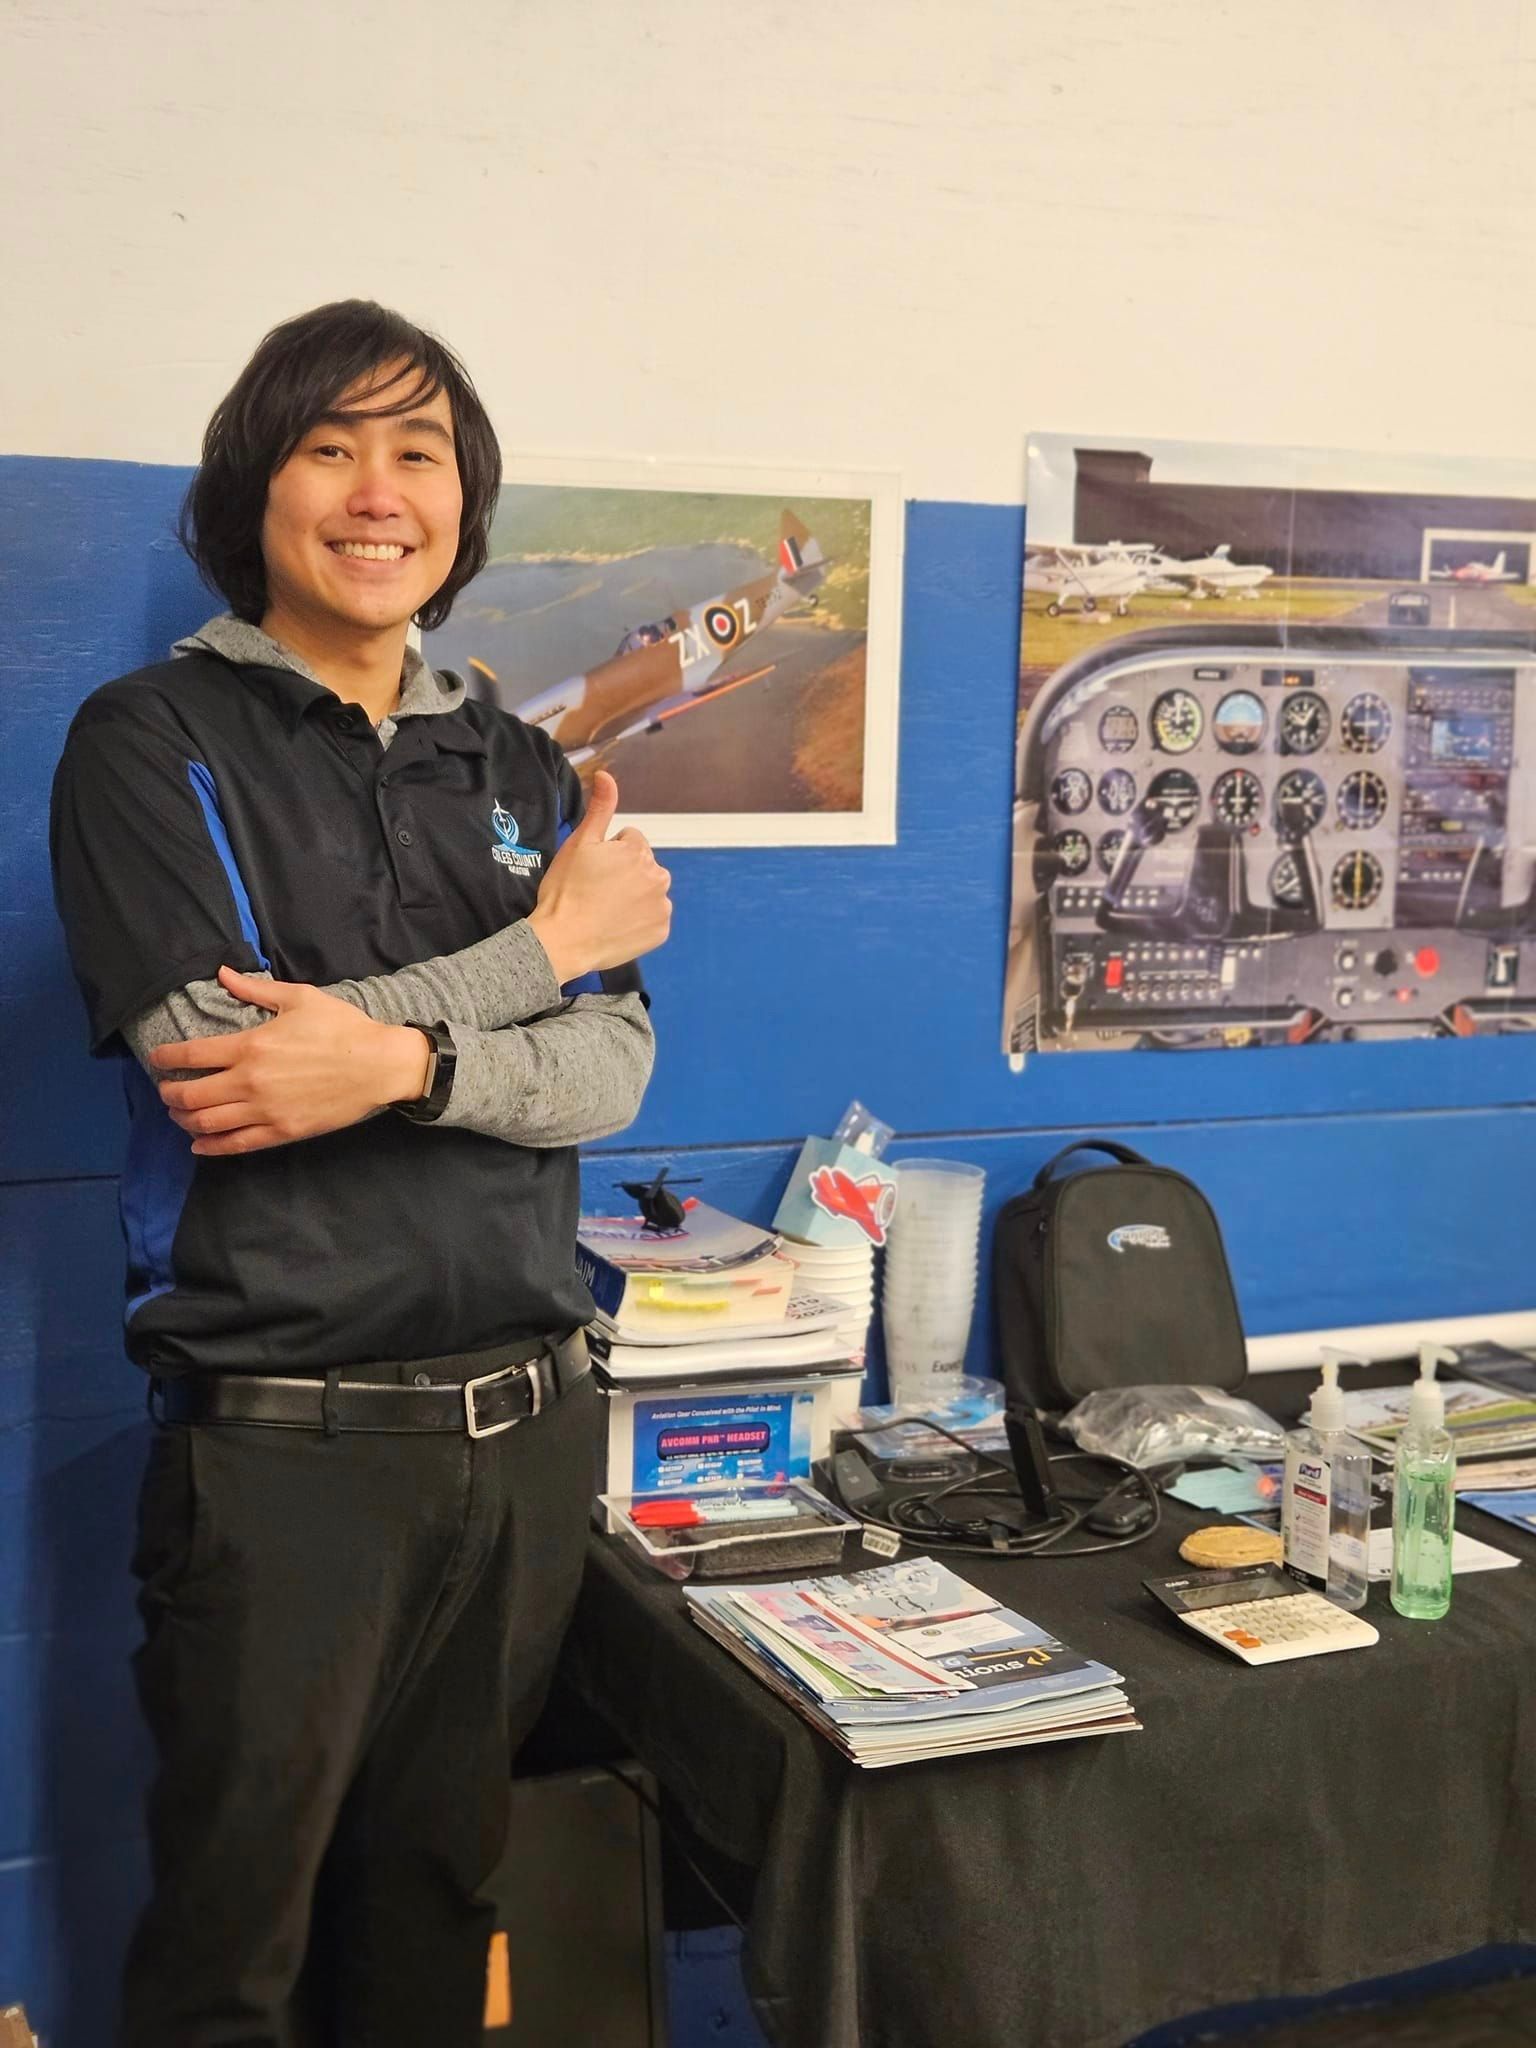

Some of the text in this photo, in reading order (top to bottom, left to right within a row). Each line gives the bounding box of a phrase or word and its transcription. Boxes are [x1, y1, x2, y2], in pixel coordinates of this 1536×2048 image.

[668, 624, 711, 669] ZX
[733, 597, 758, 635] Z
[512, 851, 542, 869] COUNTY
[651, 1412, 676, 1420] Aviation
[677, 1410, 691, 1418] Gear
[691, 1408, 722, 1417] Conceived
[722, 1406, 735, 1415] with
[735, 1405, 745, 1414] the
[745, 1405, 760, 1413] Pilot
[661, 1435, 700, 1449] AVCOMM
[727, 1431, 766, 1443] HEADSET
